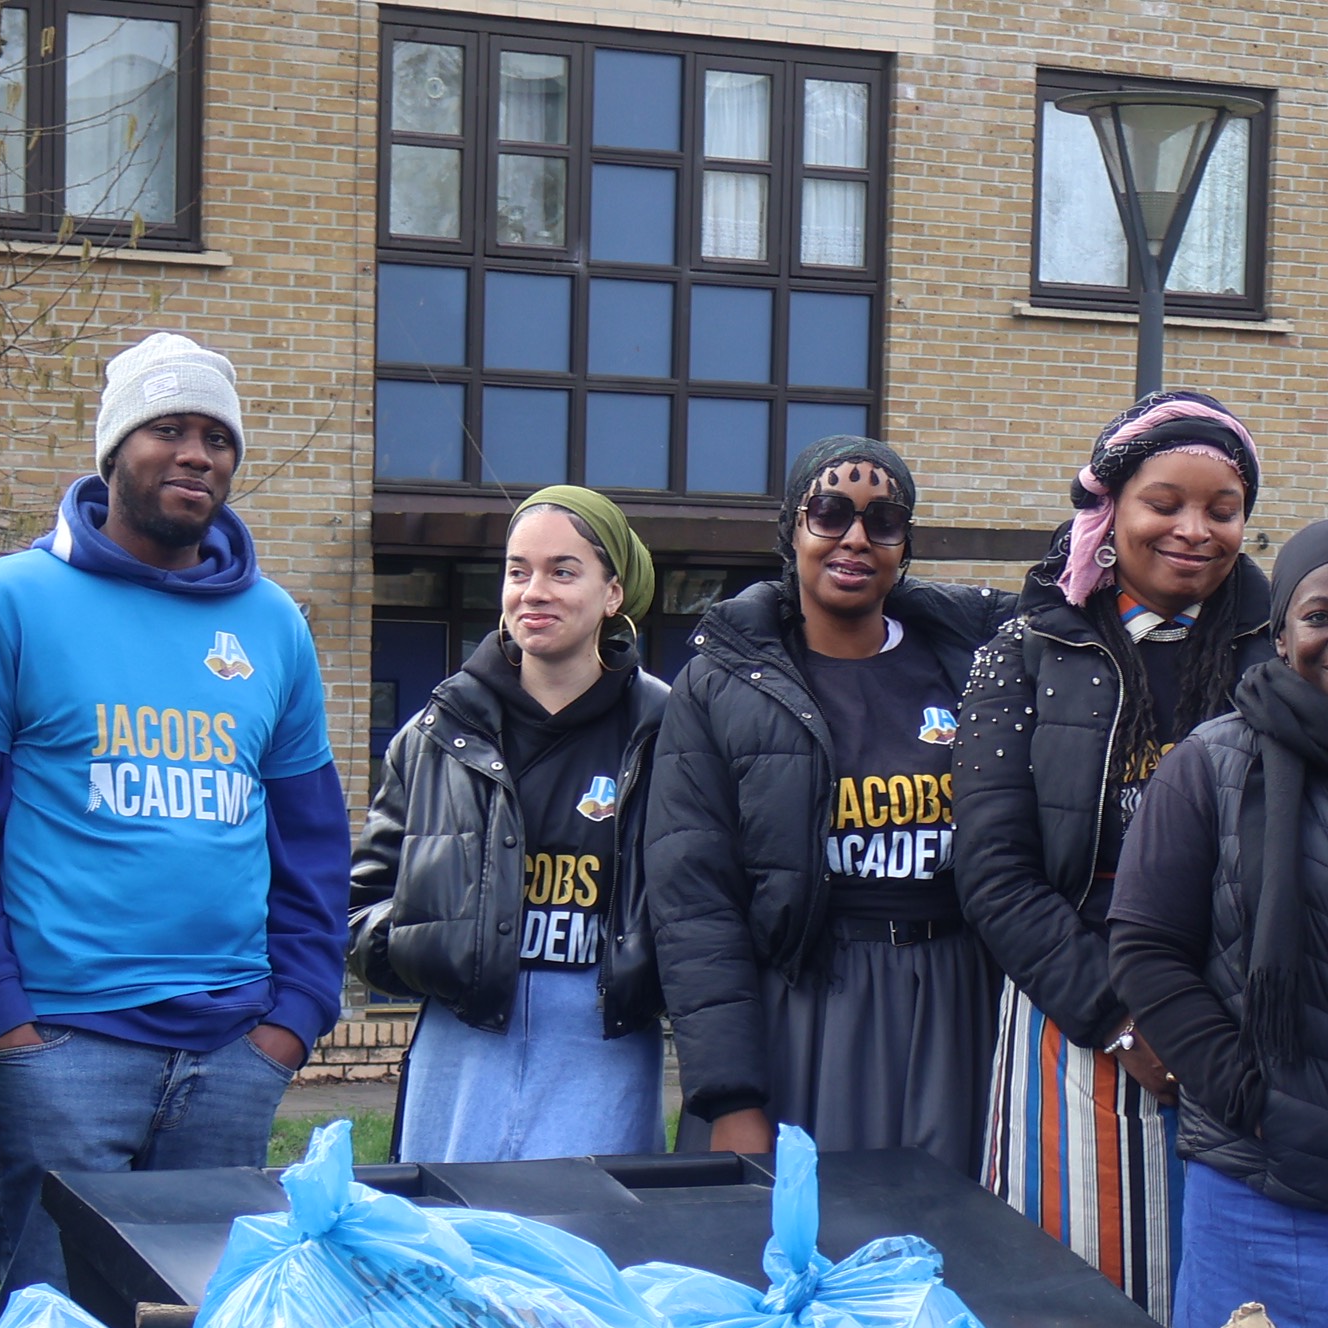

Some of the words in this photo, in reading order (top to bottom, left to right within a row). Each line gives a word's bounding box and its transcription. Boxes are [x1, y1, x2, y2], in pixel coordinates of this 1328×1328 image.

[91, 703, 237, 765] JACOBS
[84, 762, 253, 826] ACADEMY
[829, 773, 953, 830] ACOBS
